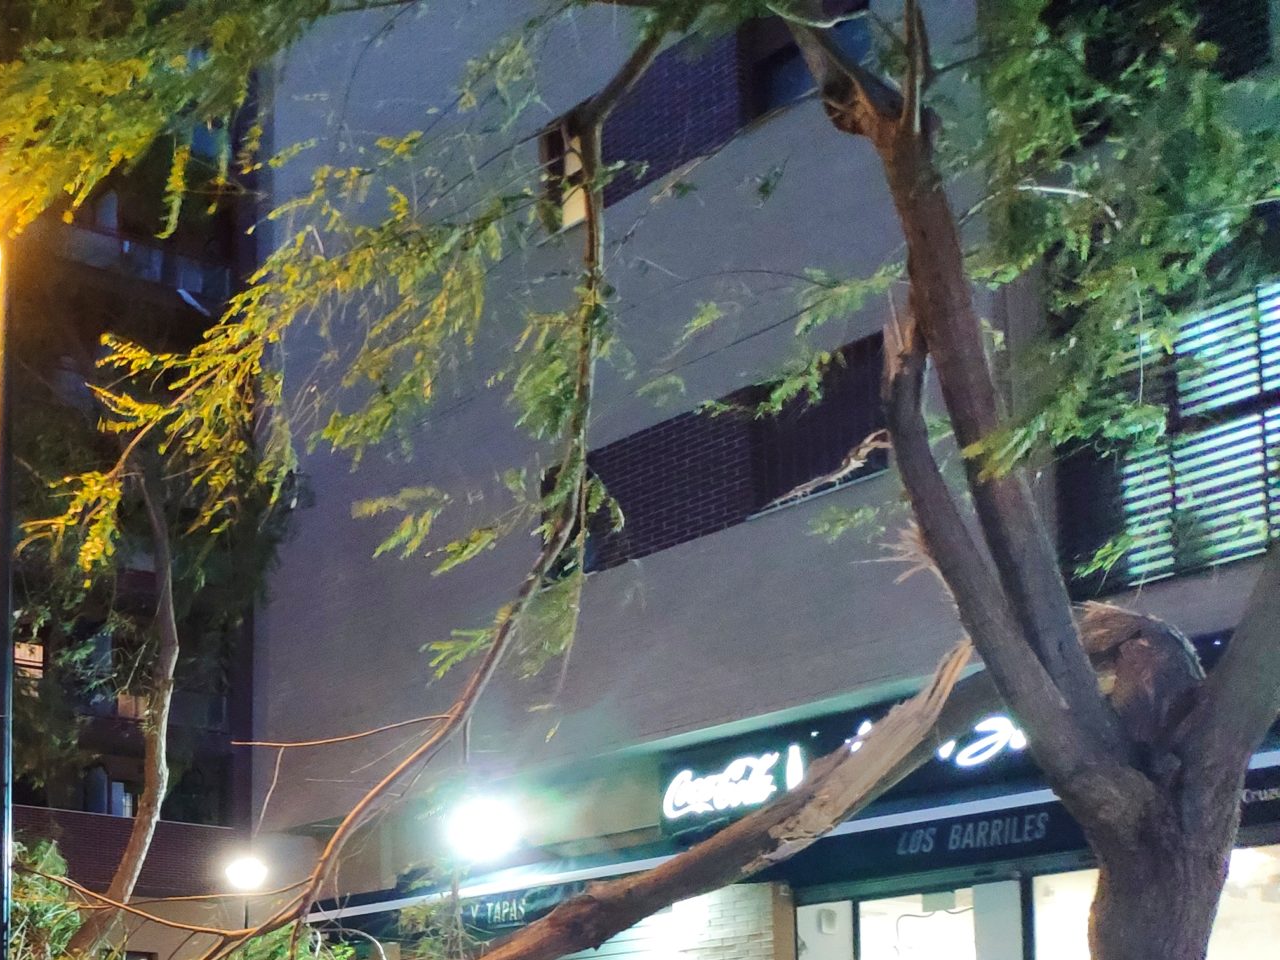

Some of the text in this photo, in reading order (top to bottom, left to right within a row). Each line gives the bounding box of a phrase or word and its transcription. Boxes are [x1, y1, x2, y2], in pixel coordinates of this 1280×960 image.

[896, 812, 1049, 855] LOS BARRILES
[486, 898, 526, 924] TAPAS
